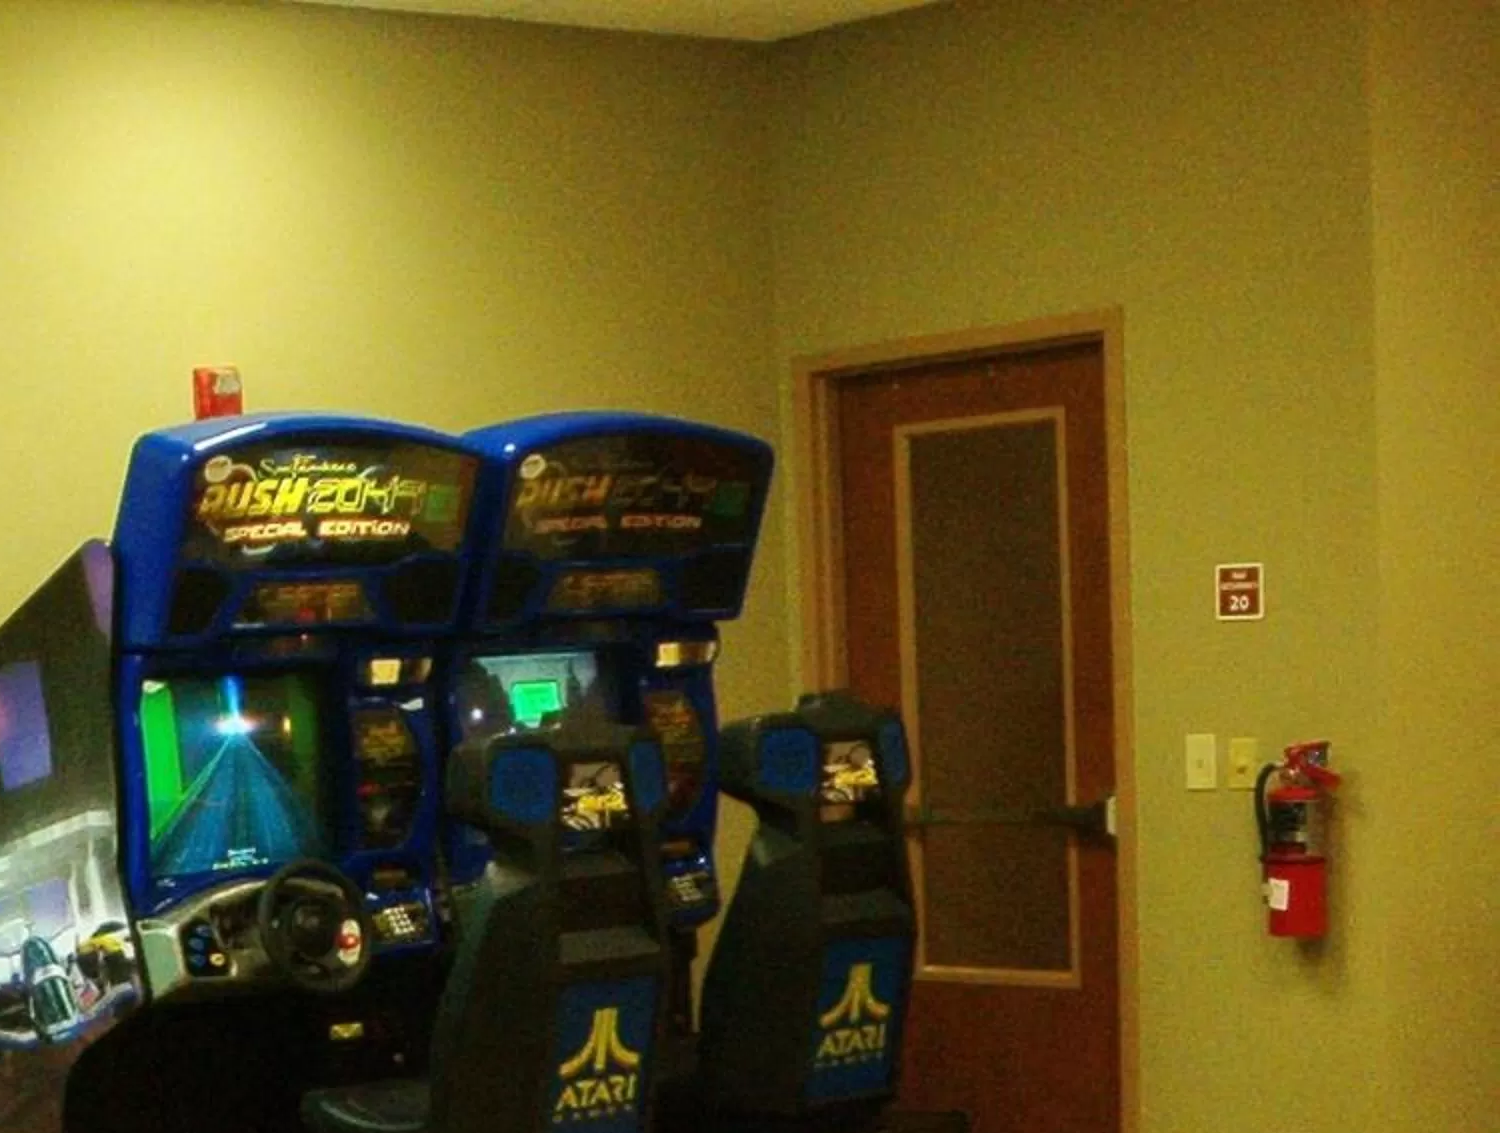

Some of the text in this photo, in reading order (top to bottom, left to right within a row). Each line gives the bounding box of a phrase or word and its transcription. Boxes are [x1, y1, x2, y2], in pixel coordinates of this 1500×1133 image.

[200, 477, 309, 516] RUSH
[223, 520, 411, 542] SPECIAL EDITION
[1230, 595, 1249, 611] 20
[814, 1023, 886, 1059] ATARI
[556, 1073, 637, 1111] ATARI
